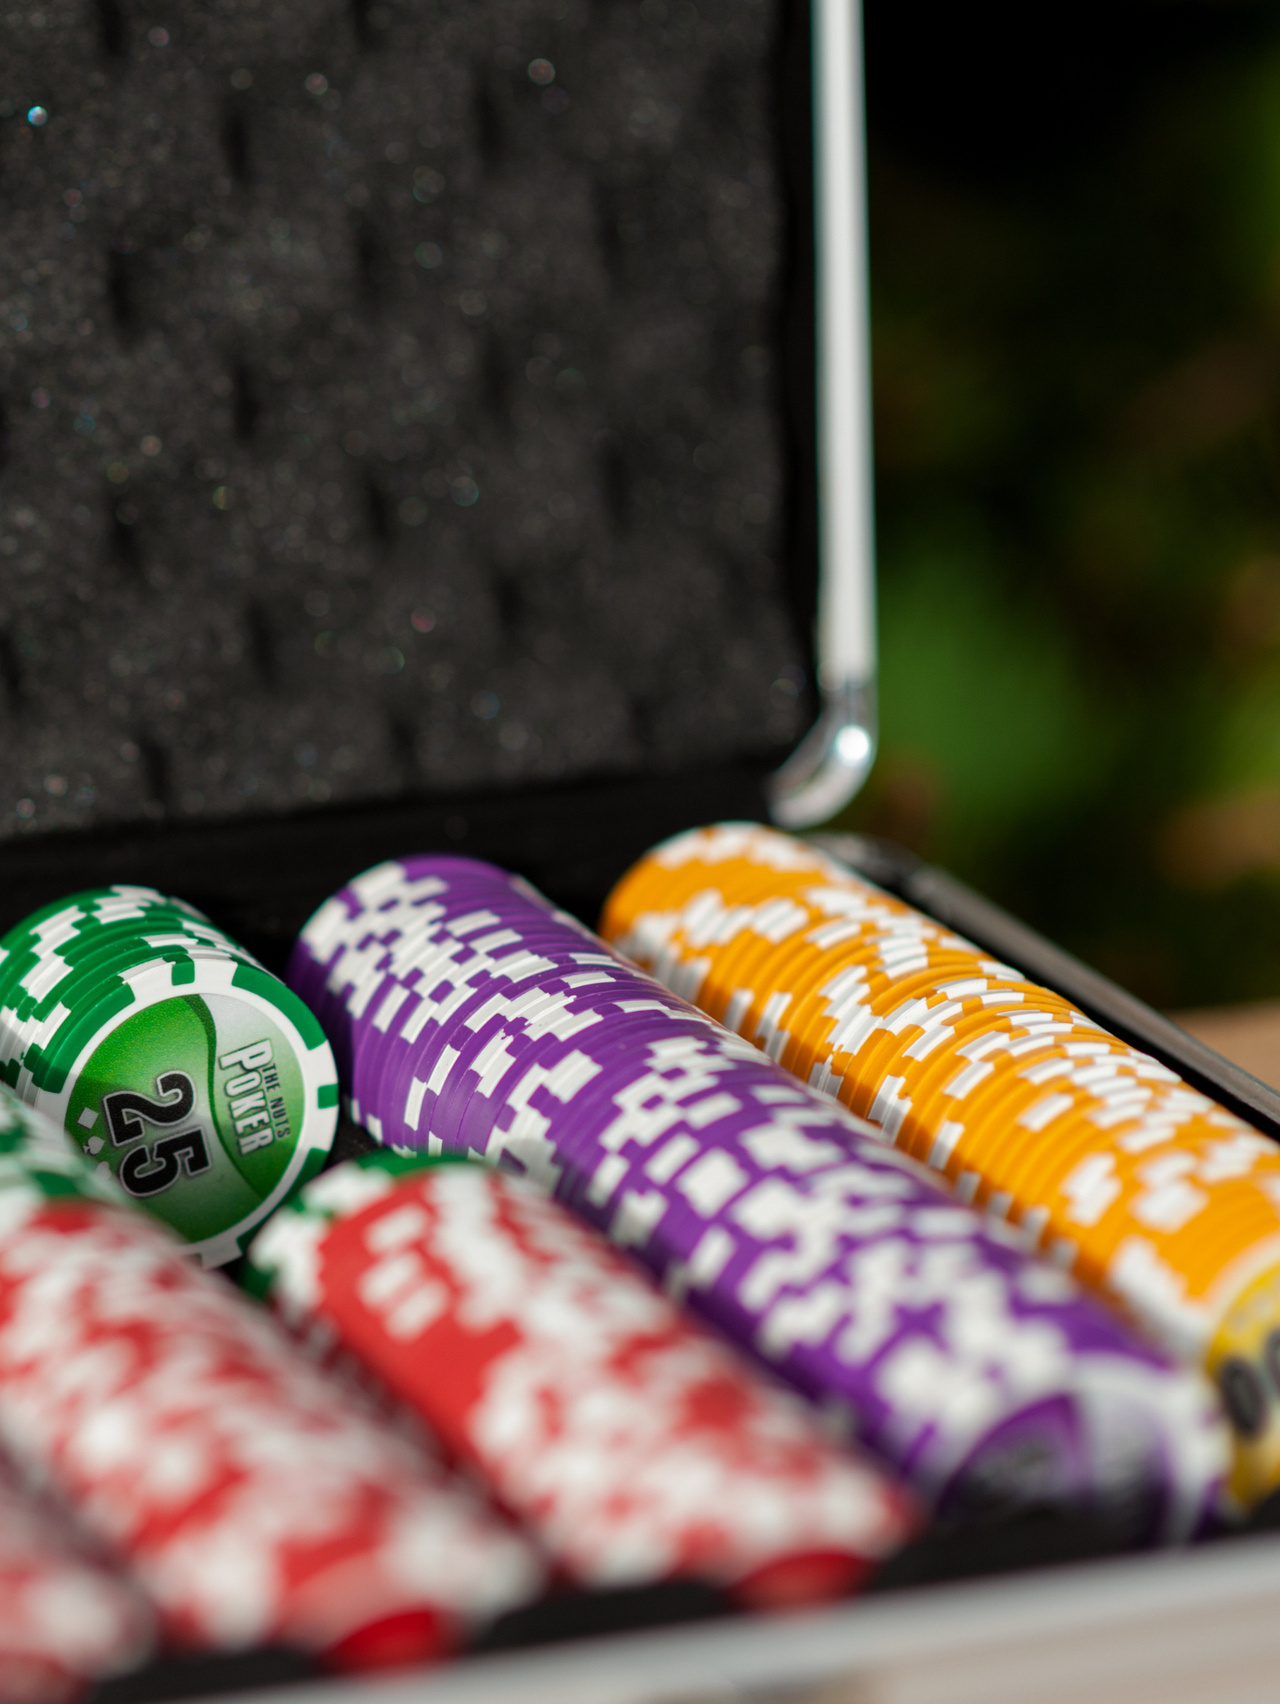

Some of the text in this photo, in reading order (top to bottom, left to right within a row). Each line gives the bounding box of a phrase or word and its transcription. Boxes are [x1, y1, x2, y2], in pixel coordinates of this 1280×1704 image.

[103, 1071, 211, 1196] 25
[218, 1039, 274, 1156] POKER
[261, 1063, 291, 1139] THE NUTS
